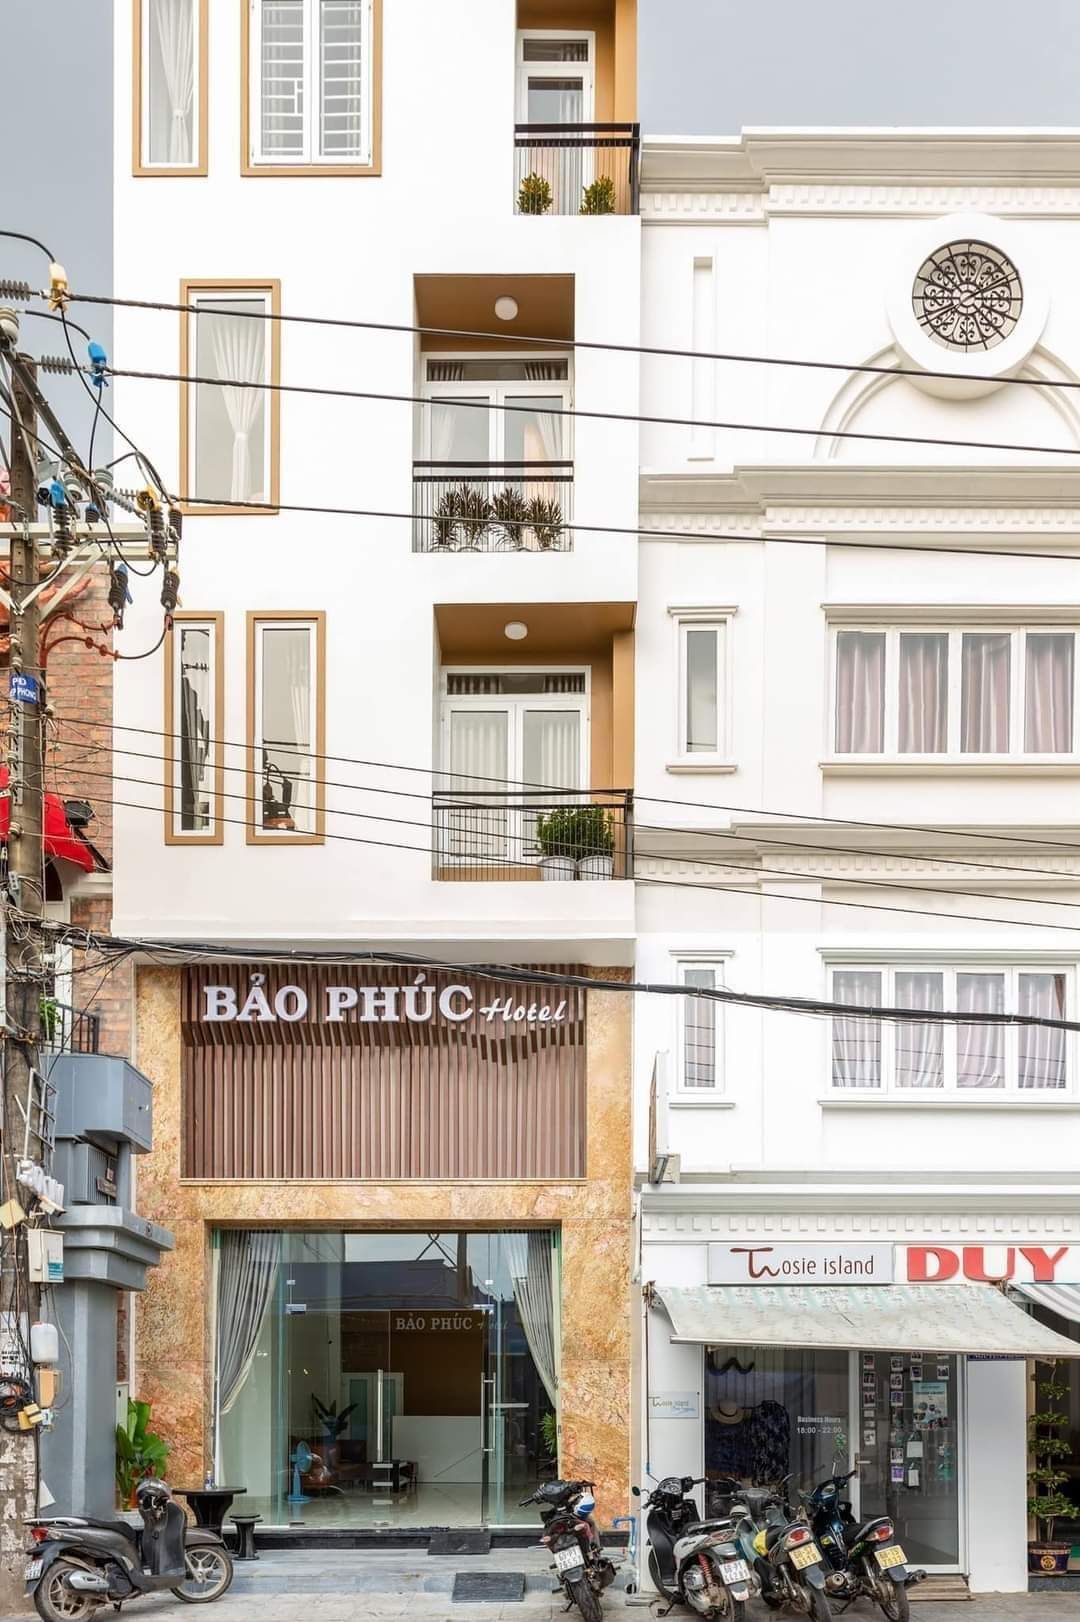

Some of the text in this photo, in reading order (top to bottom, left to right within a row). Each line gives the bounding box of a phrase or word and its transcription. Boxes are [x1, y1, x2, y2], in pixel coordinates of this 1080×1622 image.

[203, 973, 567, 1022] BẢO PHÚC Hotel
[824, 1255, 874, 1275] island
[907, 1246, 1069, 1283] DUY
[431, 1312, 473, 1330] PHÚC
